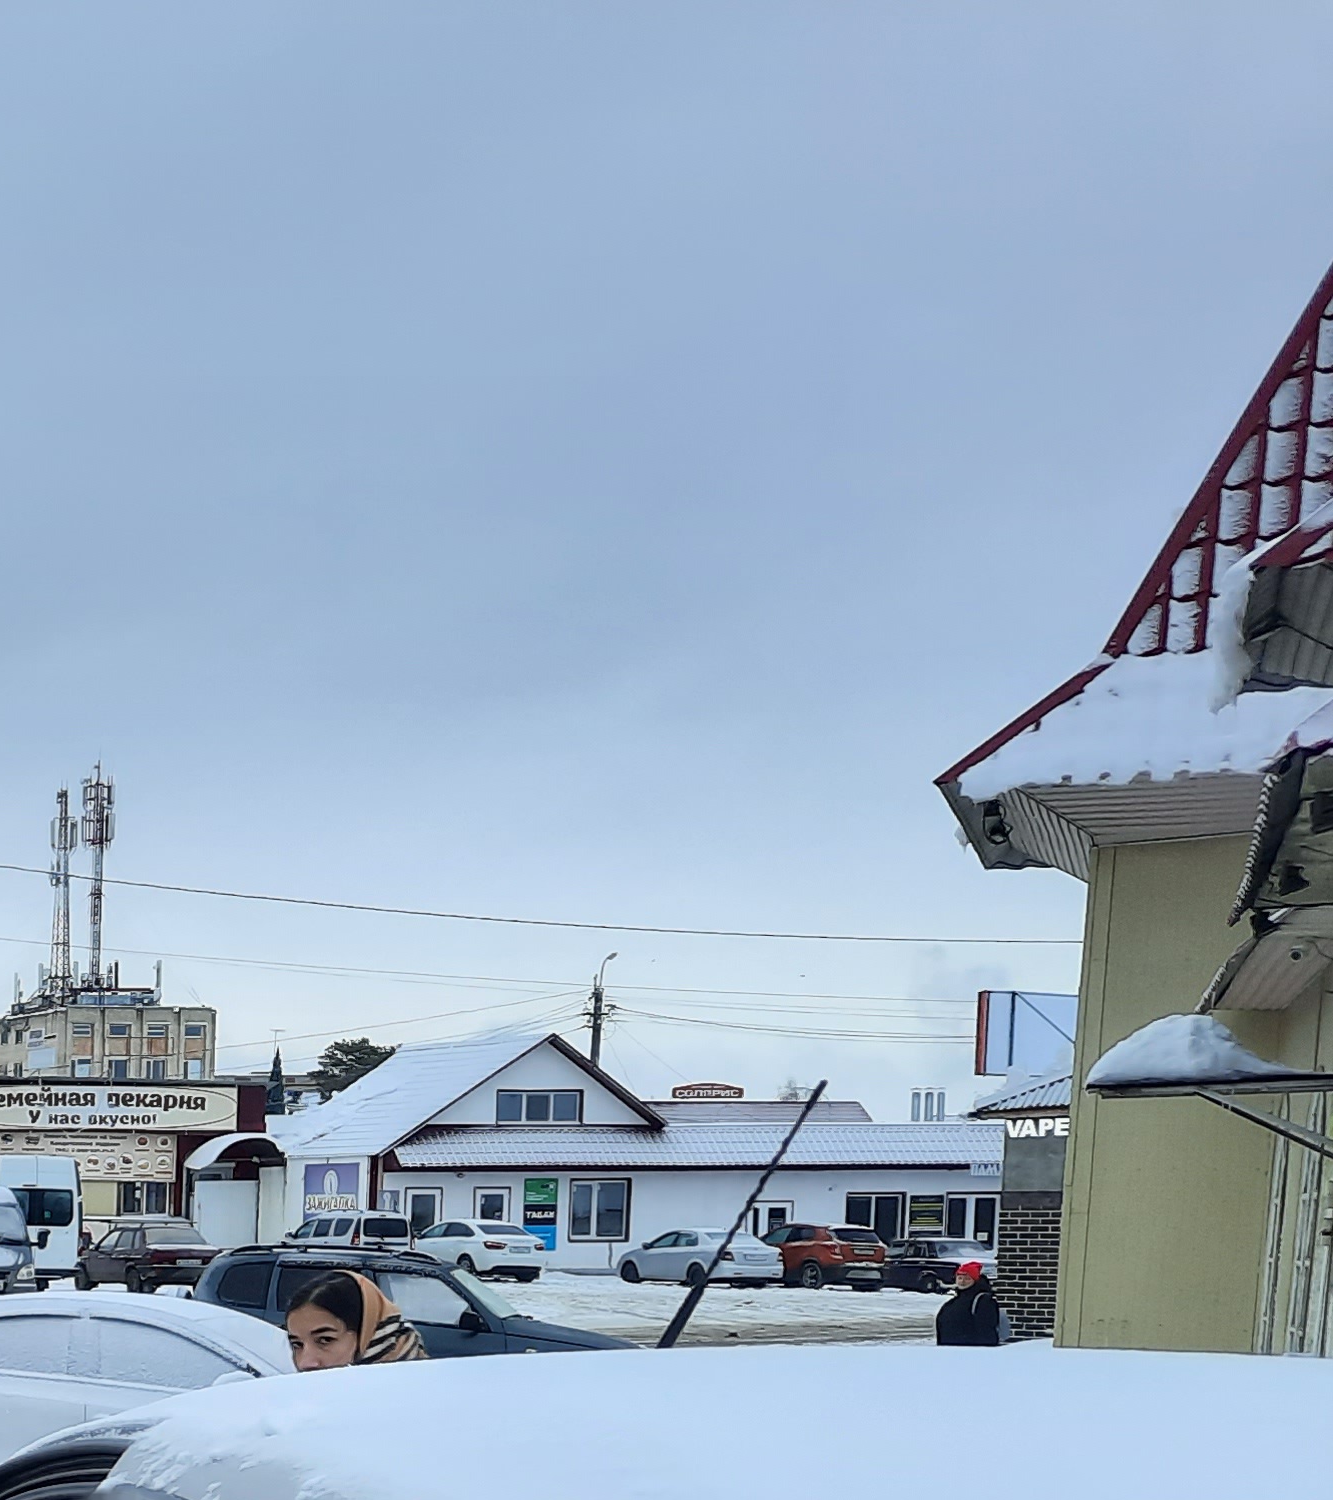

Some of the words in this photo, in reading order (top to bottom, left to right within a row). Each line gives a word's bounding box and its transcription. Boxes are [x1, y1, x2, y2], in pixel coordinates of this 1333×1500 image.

[108, 1092, 207, 1112] пекарня
[28, 1110, 41, 1124] У
[48, 1114, 81, 1125] нас
[87, 1113, 158, 1127] вкусно!
[1005, 1118, 1070, 1138] VAPE
